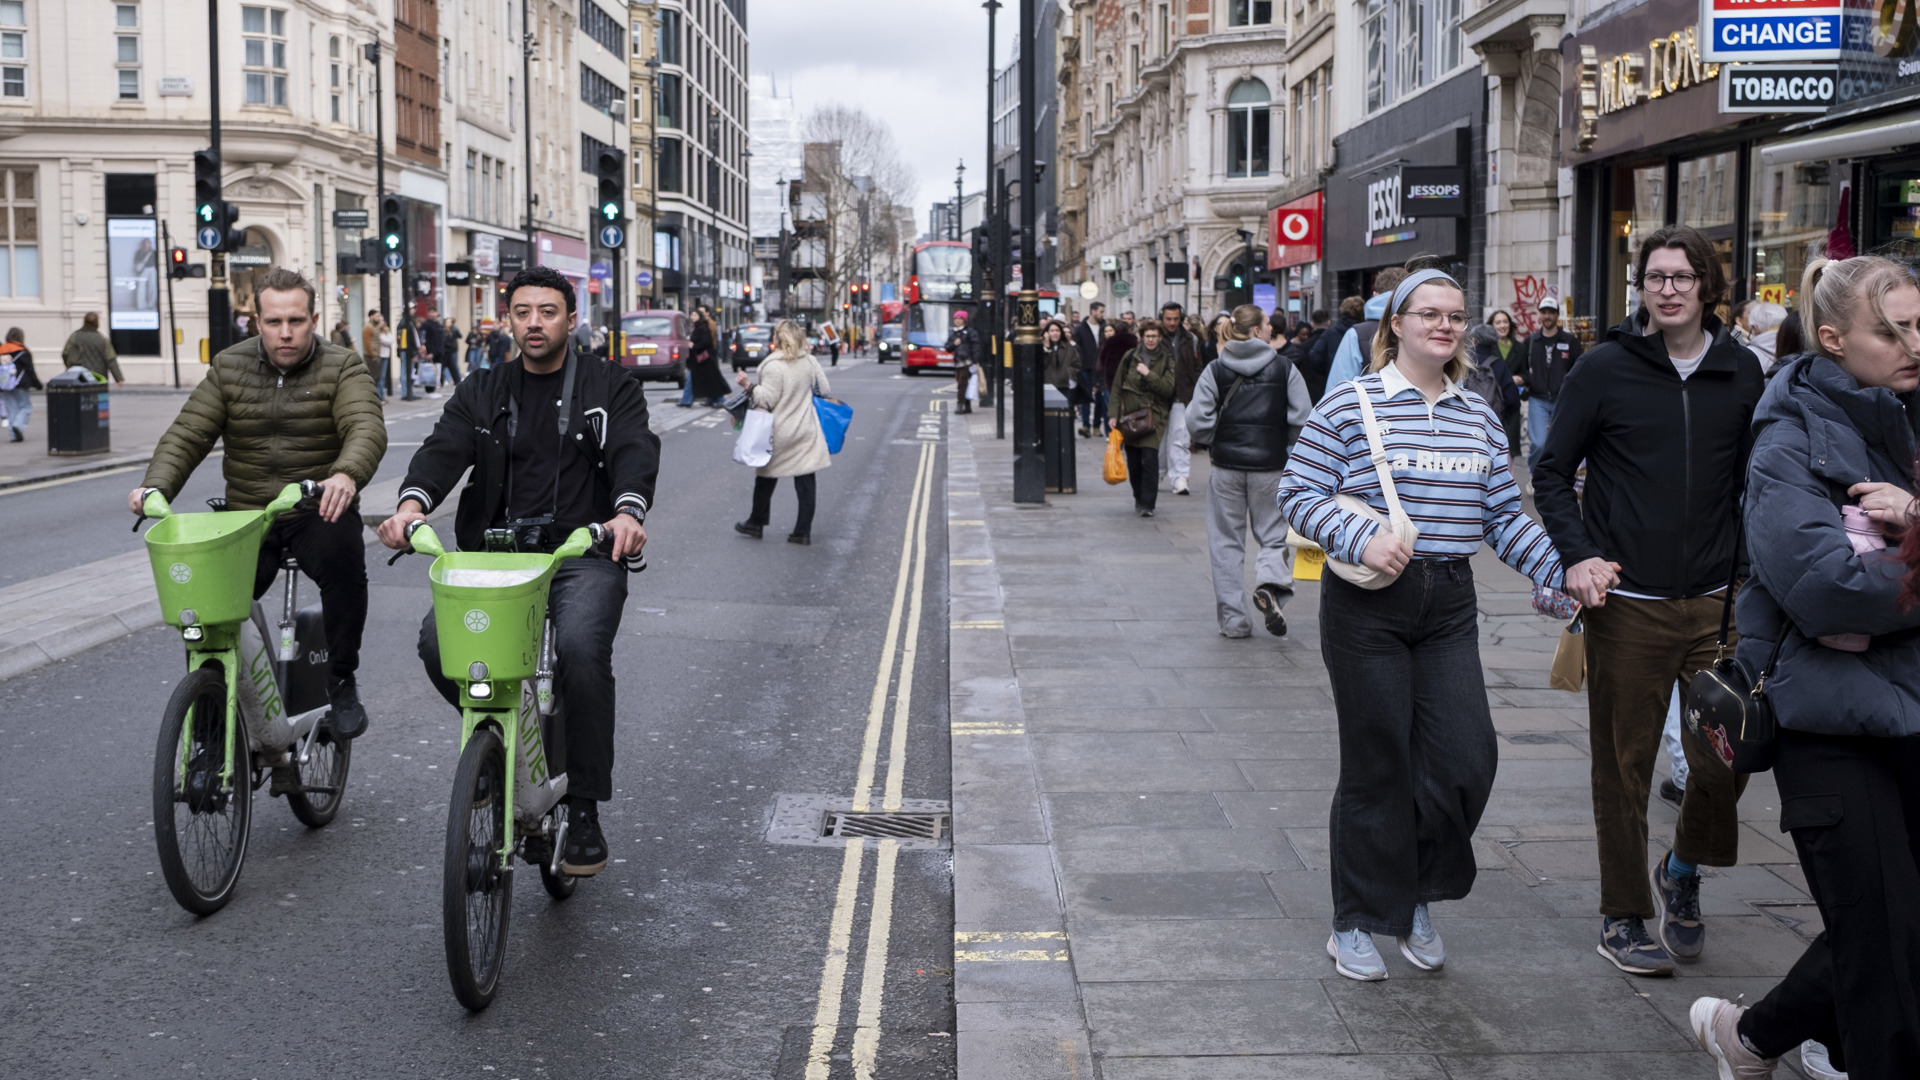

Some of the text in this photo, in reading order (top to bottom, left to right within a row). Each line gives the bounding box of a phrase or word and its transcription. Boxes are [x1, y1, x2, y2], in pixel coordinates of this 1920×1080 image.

[1722, 22, 1831, 45] CHANGE
[1649, 26, 1720, 99] LON
[1732, 76, 1834, 101] TOBACCO
[1407, 184, 1460, 199] JESSOPS
[1365, 174, 1417, 247] JESSO
[959, 282, 972, 293] 98
[1763, 289, 1781, 304] £1
[1388, 453, 1408, 471] a
[309, 651, 321, 665] On
[249, 646, 282, 721] Lime
[520, 702, 546, 784] Lime
